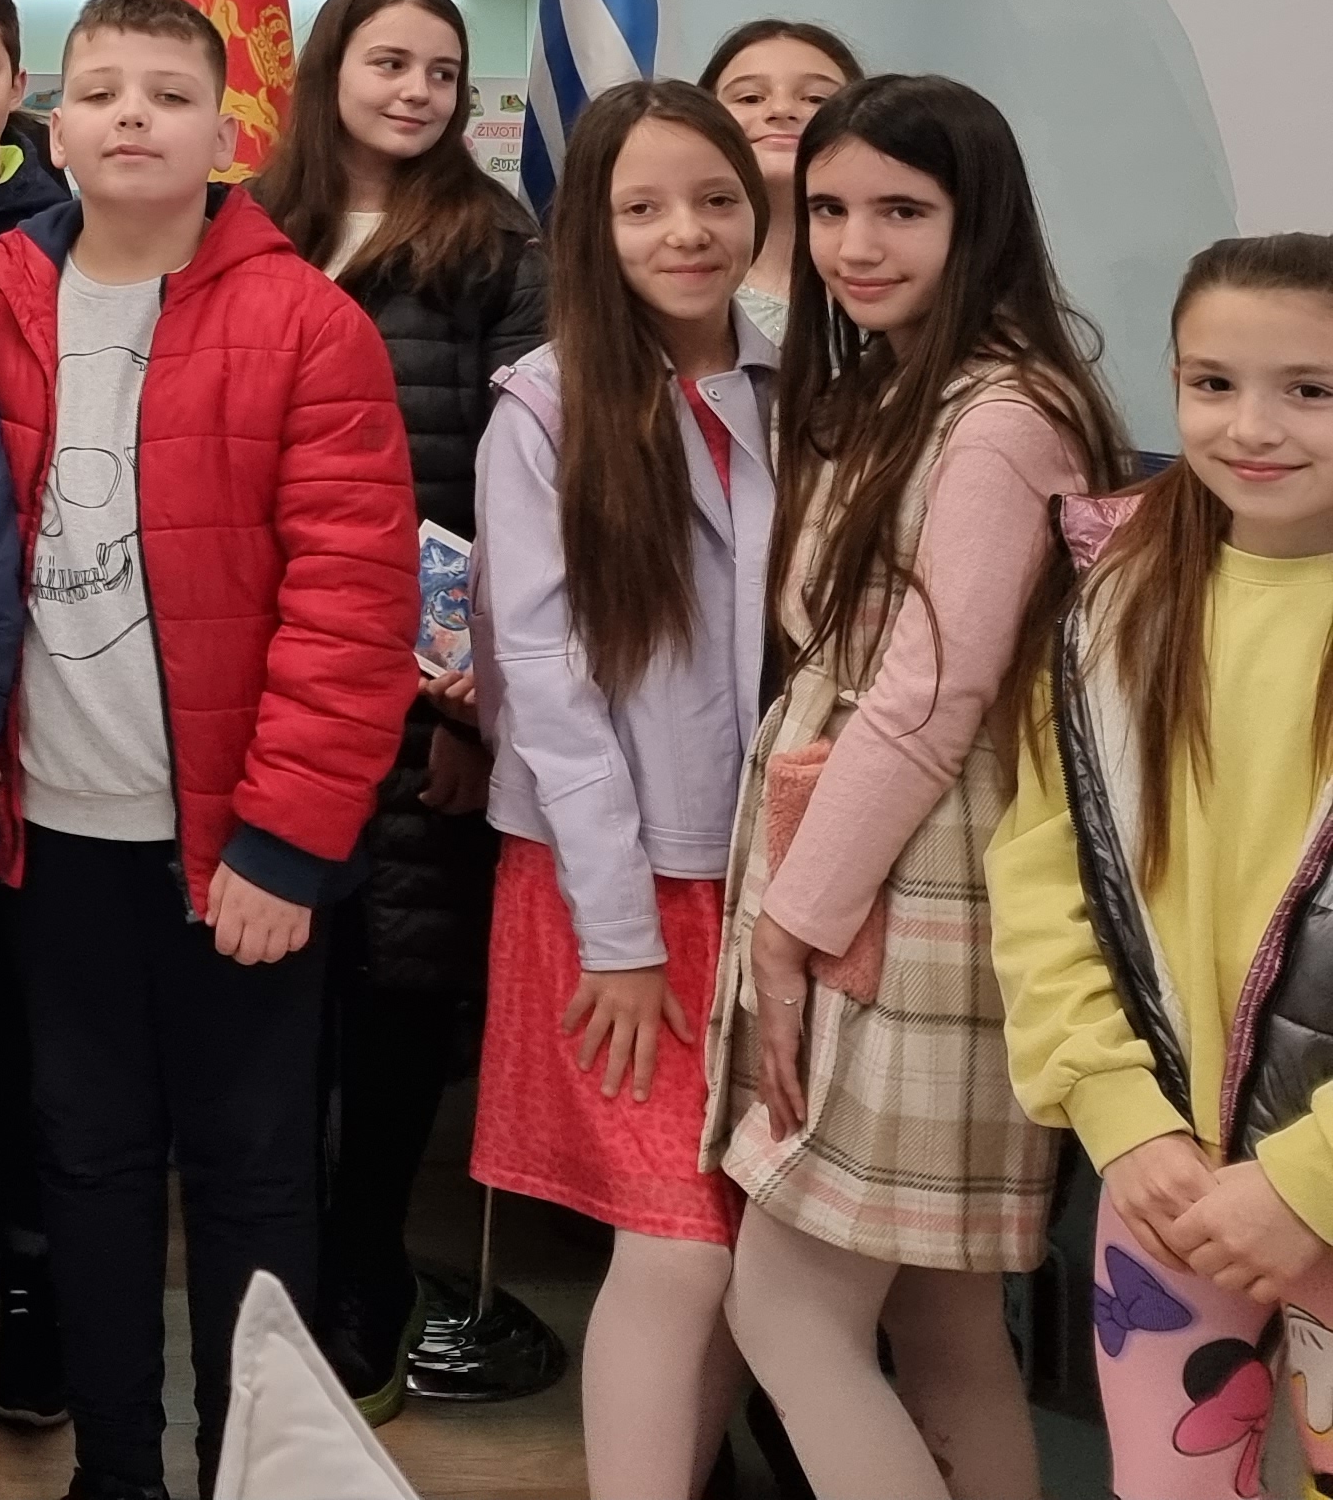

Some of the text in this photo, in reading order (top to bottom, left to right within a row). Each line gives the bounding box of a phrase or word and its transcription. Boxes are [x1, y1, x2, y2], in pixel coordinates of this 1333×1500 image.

[477, 123, 522, 137] ŽIVOTI
[507, 143, 515, 154] U
[490, 156, 521, 173] ŠUM
